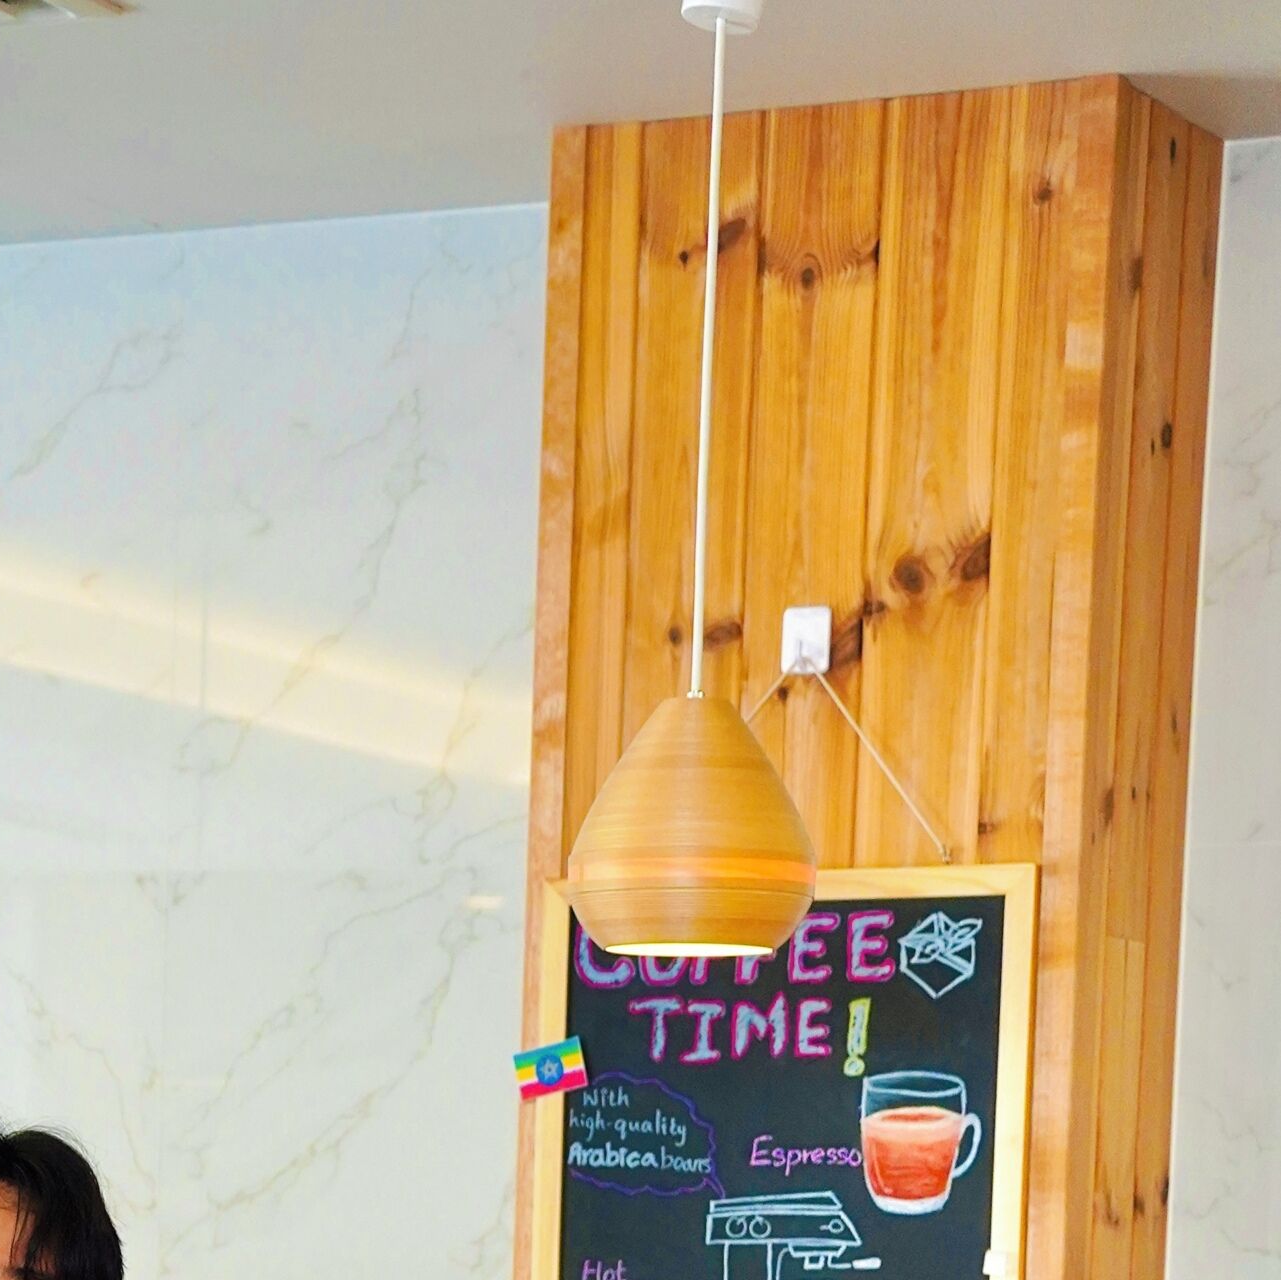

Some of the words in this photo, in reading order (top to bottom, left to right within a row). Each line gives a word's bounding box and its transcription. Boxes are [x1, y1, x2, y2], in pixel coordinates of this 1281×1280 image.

[629, 991, 871, 1077] TIME!
[569, 1107, 687, 1147] high-quality
[567, 1141, 658, 1168] Arabica
[749, 1134, 863, 1177] Espresso
